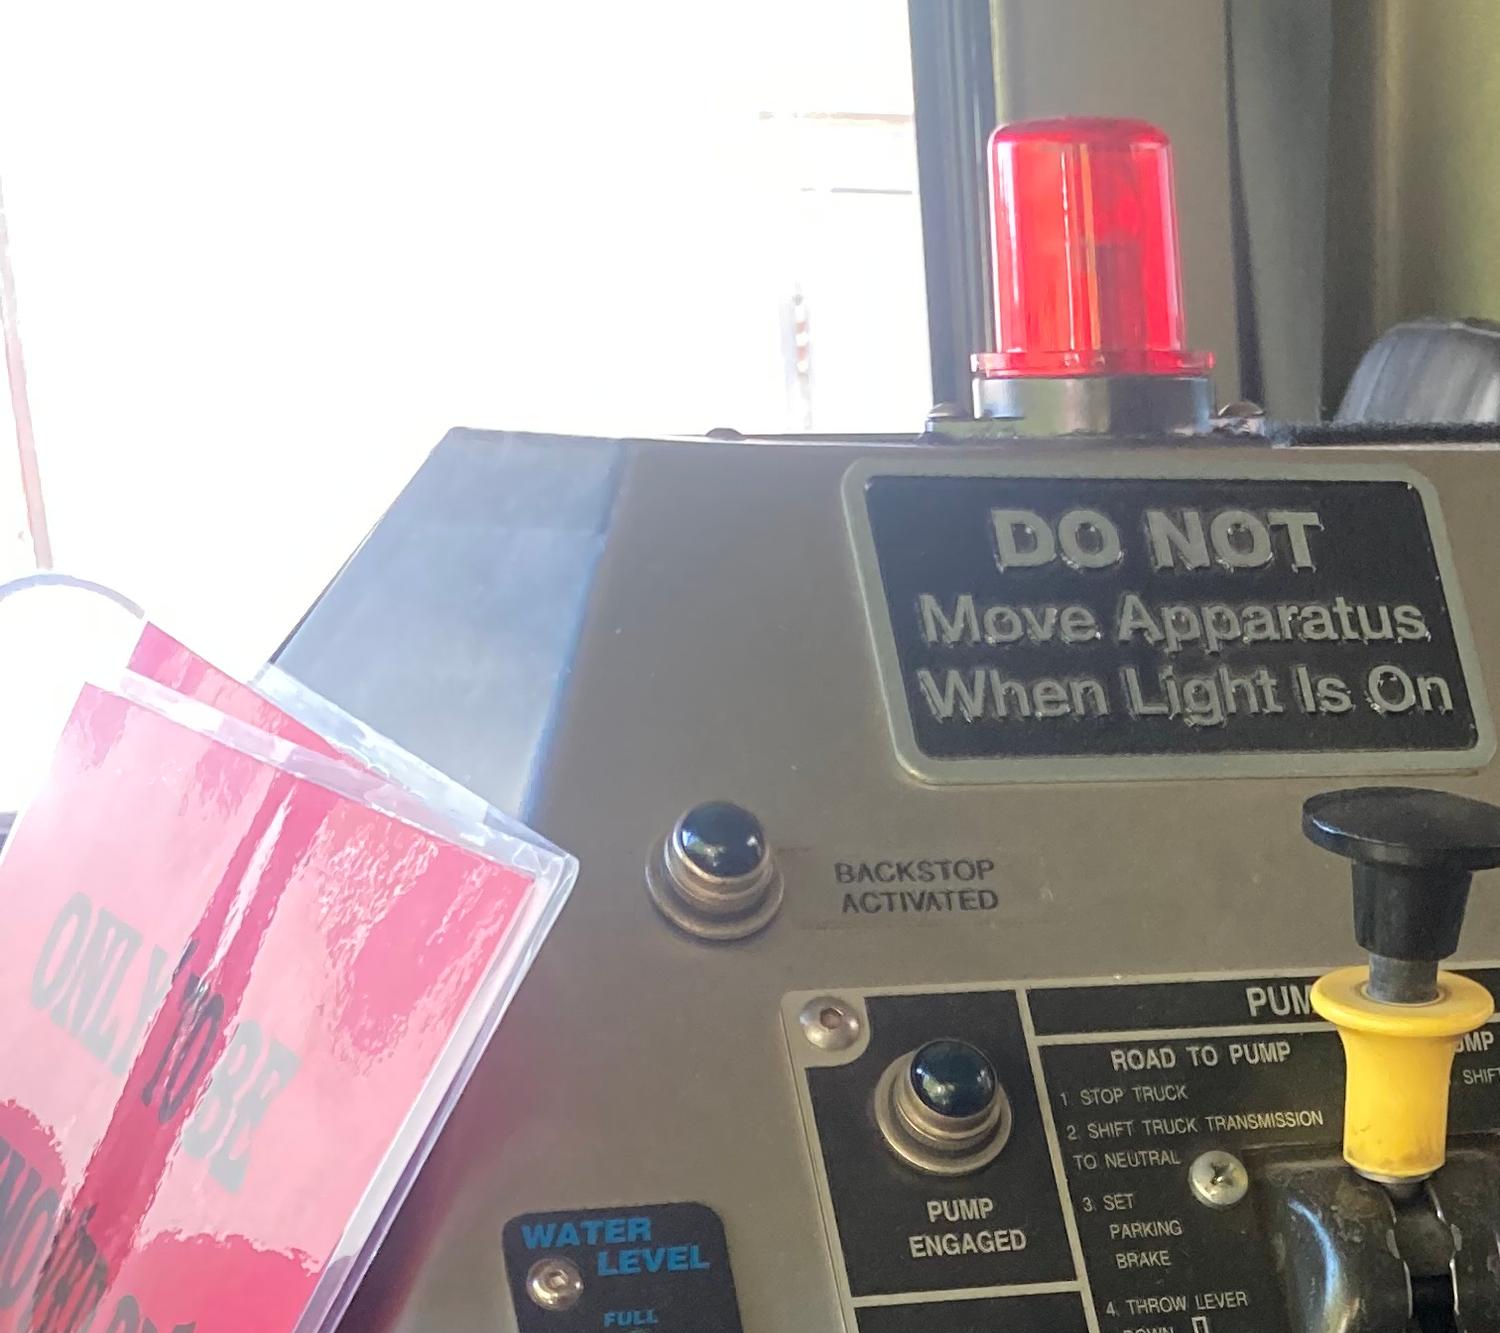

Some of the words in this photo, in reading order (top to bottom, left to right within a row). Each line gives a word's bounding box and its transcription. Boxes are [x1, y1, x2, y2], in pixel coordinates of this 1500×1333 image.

[991, 509, 1123, 573] DO
[1145, 509, 1325, 573] NOT
[918, 593, 1102, 645] Move
[1117, 595, 1430, 655] Apparatus
[917, 668, 1108, 723] When
[1121, 667, 1283, 727] Light
[1298, 667, 1356, 715] Is
[1369, 667, 1453, 715] On
[834, 859, 994, 884] BACKSTOP
[842, 889, 998, 914] ACTIVATED
[31, 890, 200, 1077] ONLY
[1246, 985, 1314, 1017] PUM
[140, 971, 226, 1125] TO
[1452, 1030, 1494, 1053] MP
[1112, 1049, 1176, 1071] ROAD
[1186, 1046, 1218, 1067] TO
[1230, 1042, 1291, 1064] PUMP
[180, 1018, 302, 1194] BE
[1080, 1087, 1124, 1106] STOP
[1132, 1085, 1189, 1102] TRUCK
[1088, 1122, 1132, 1139] SHIFT
[1142, 1118, 1198, 1135] TRUCK
[1206, 1111, 1323, 1132] TRANSMISSION
[1073, 1156, 1096, 1171] TO
[1105, 1152, 1180, 1168] NEUTRAL
[927, 1198, 994, 1223] PUMP
[1104, 1194, 1133, 1210] SET
[520, 1216, 651, 1250] WATER
[908, 1229, 1027, 1258] ENGAGED
[1110, 1220, 1182, 1239] PARKING
[597, 1244, 711, 1276] LEVEL
[1116, 1251, 1171, 1269] BRAKE
[1126, 1296, 1186, 1315] THROW
[1196, 1292, 1248, 1309] LEVER
[604, 1309, 659, 1328] FULL
